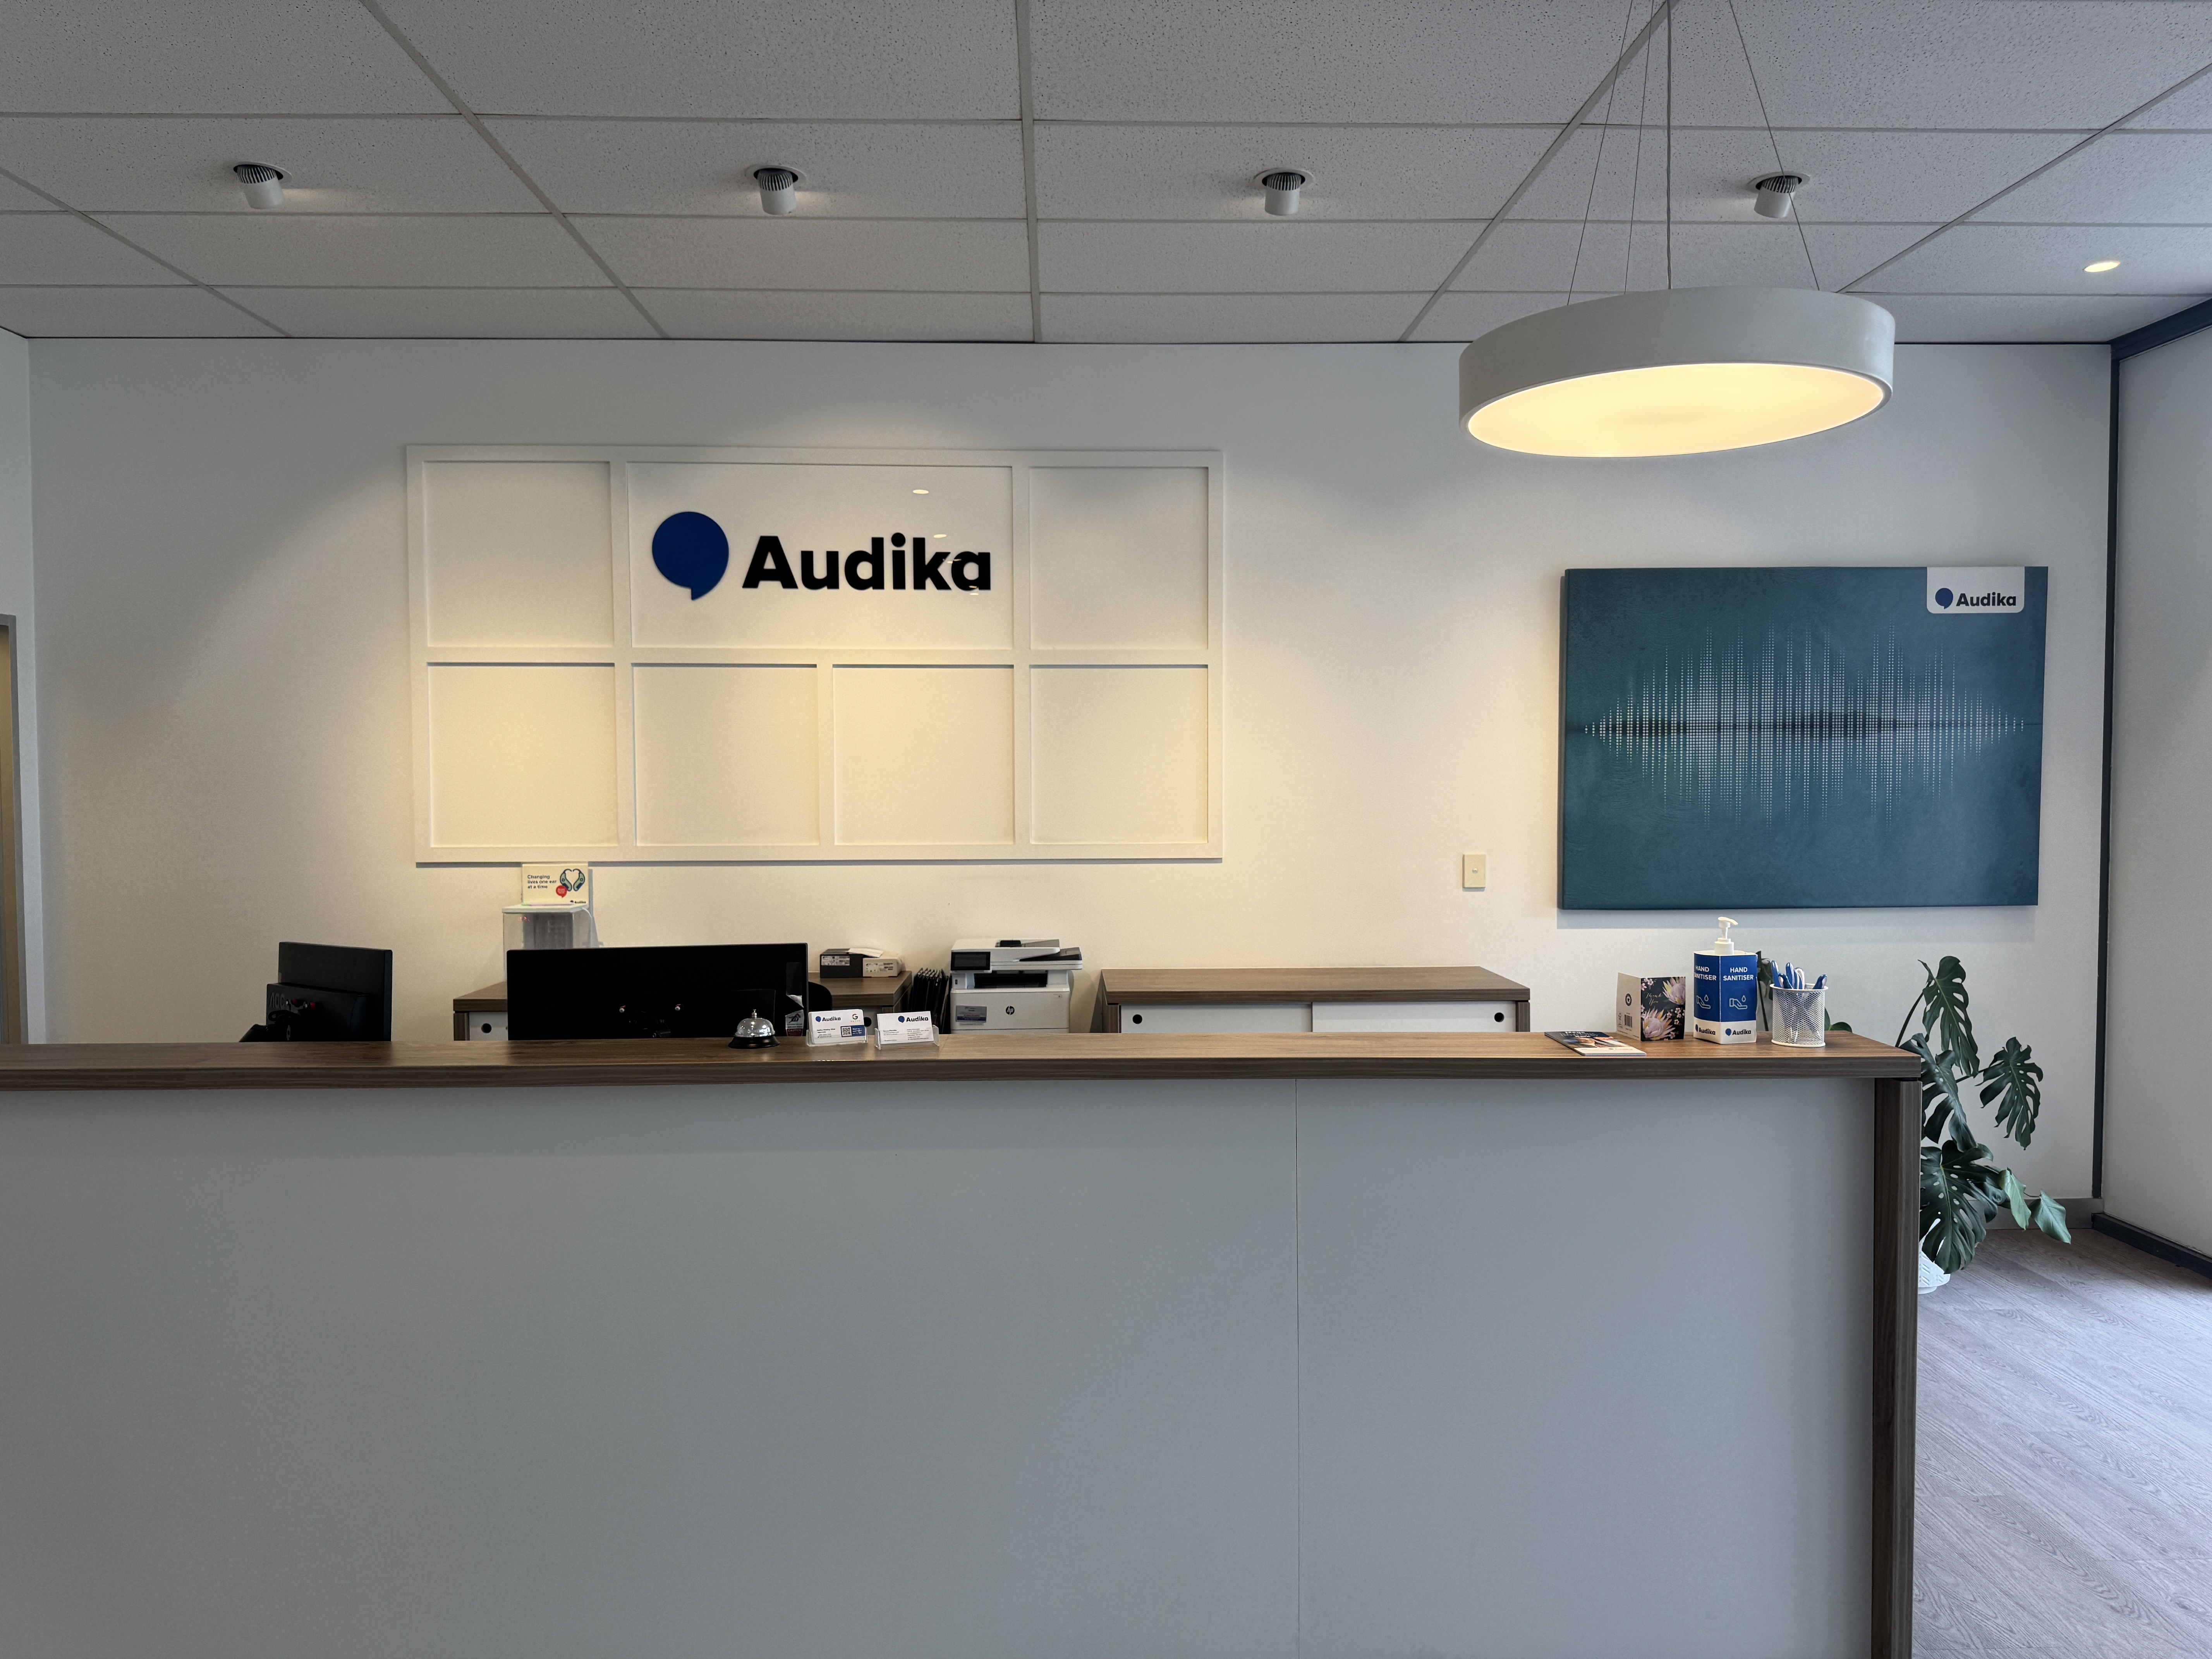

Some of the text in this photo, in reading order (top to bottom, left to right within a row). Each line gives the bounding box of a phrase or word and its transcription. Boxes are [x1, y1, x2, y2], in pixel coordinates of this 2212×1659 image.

[742, 532, 991, 591] Audika
[1956, 592, 2016, 606] Audika
[269, 992, 285, 1010] AOC
[1649, 998, 1658, 1006] You
[1007, 1006, 1014, 1015] hp
